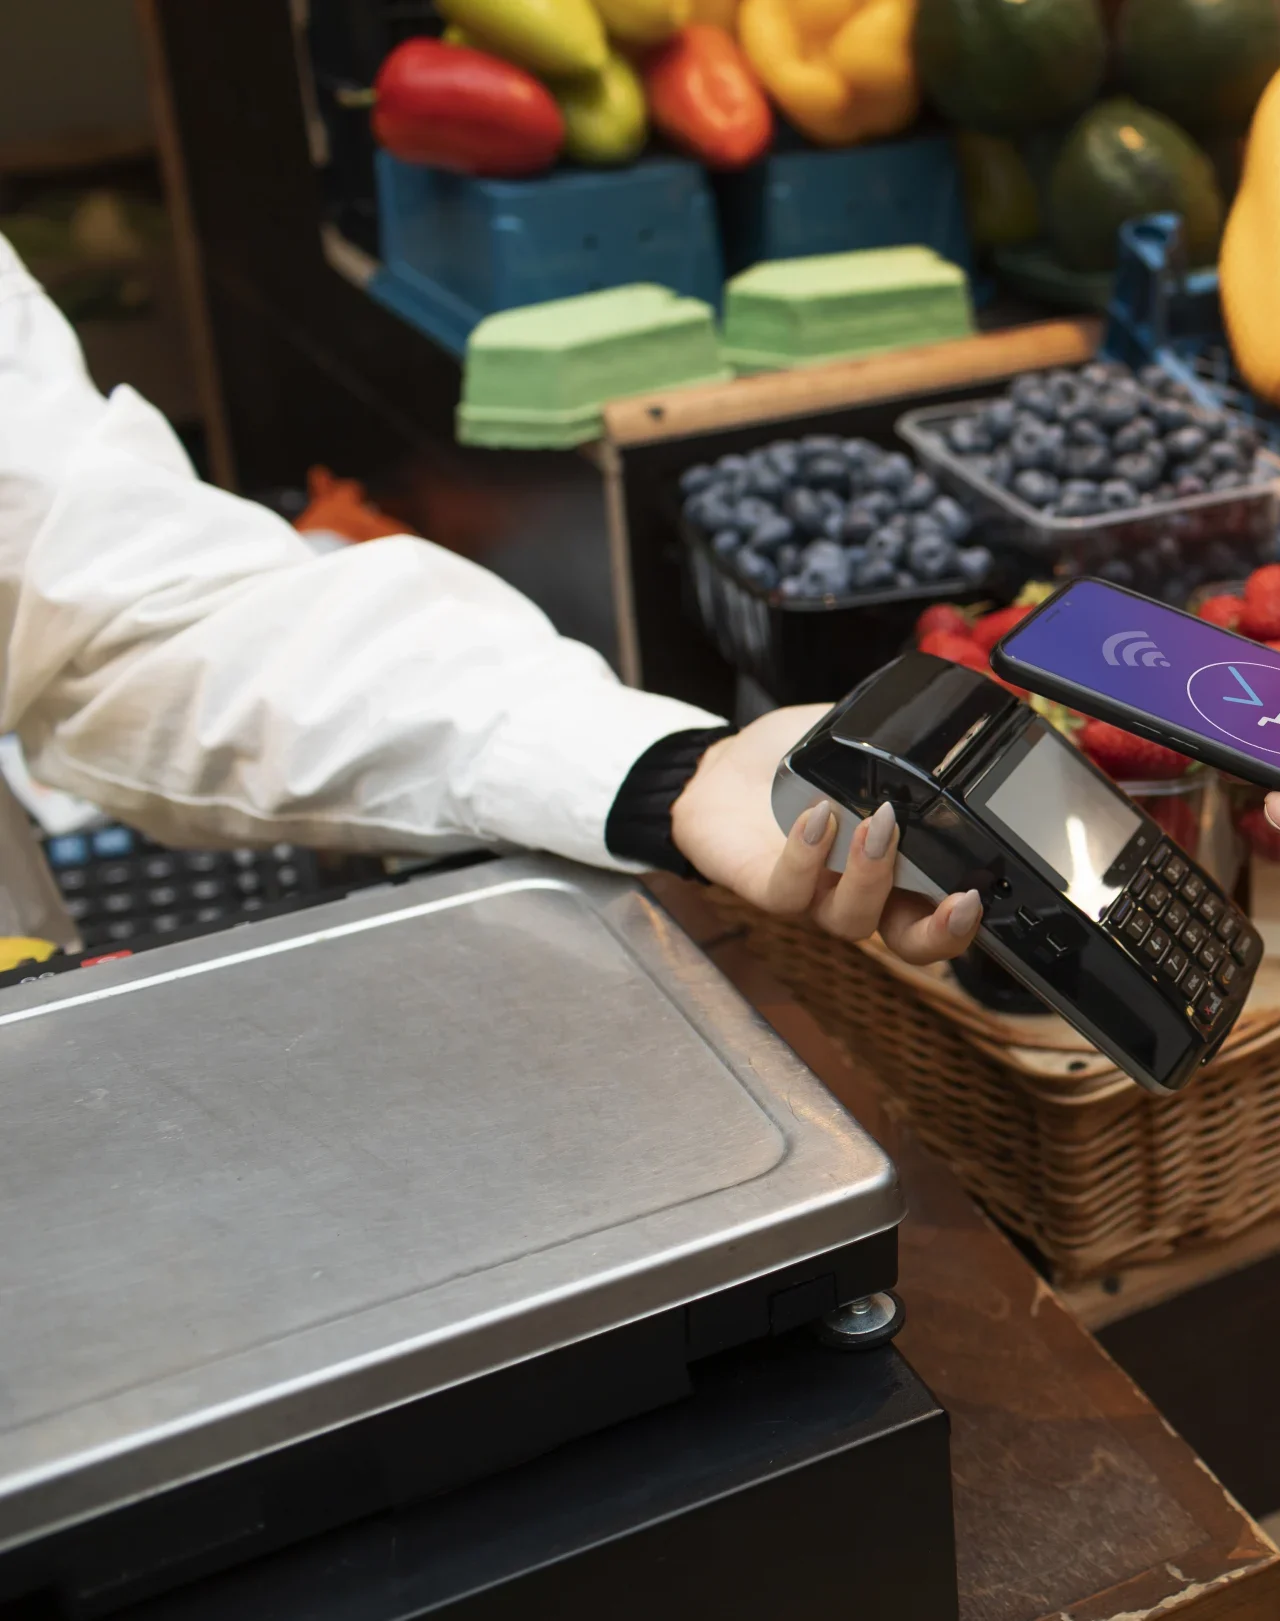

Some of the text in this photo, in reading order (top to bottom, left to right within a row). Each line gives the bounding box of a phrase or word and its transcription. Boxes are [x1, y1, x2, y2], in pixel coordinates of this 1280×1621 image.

[1167, 867, 1179, 879] 3
[1186, 885, 1197, 897] 6
[1150, 894, 1161, 905] 2
[1203, 903, 1214, 915] 9
[1168, 912, 1179, 923] 5
[1131, 922, 1143, 932] 1
[1186, 931, 1197, 942] 8
[1151, 940, 1161, 950] 4
[1203, 950, 1214, 963] 0
[1168, 958, 1178, 970] 7
